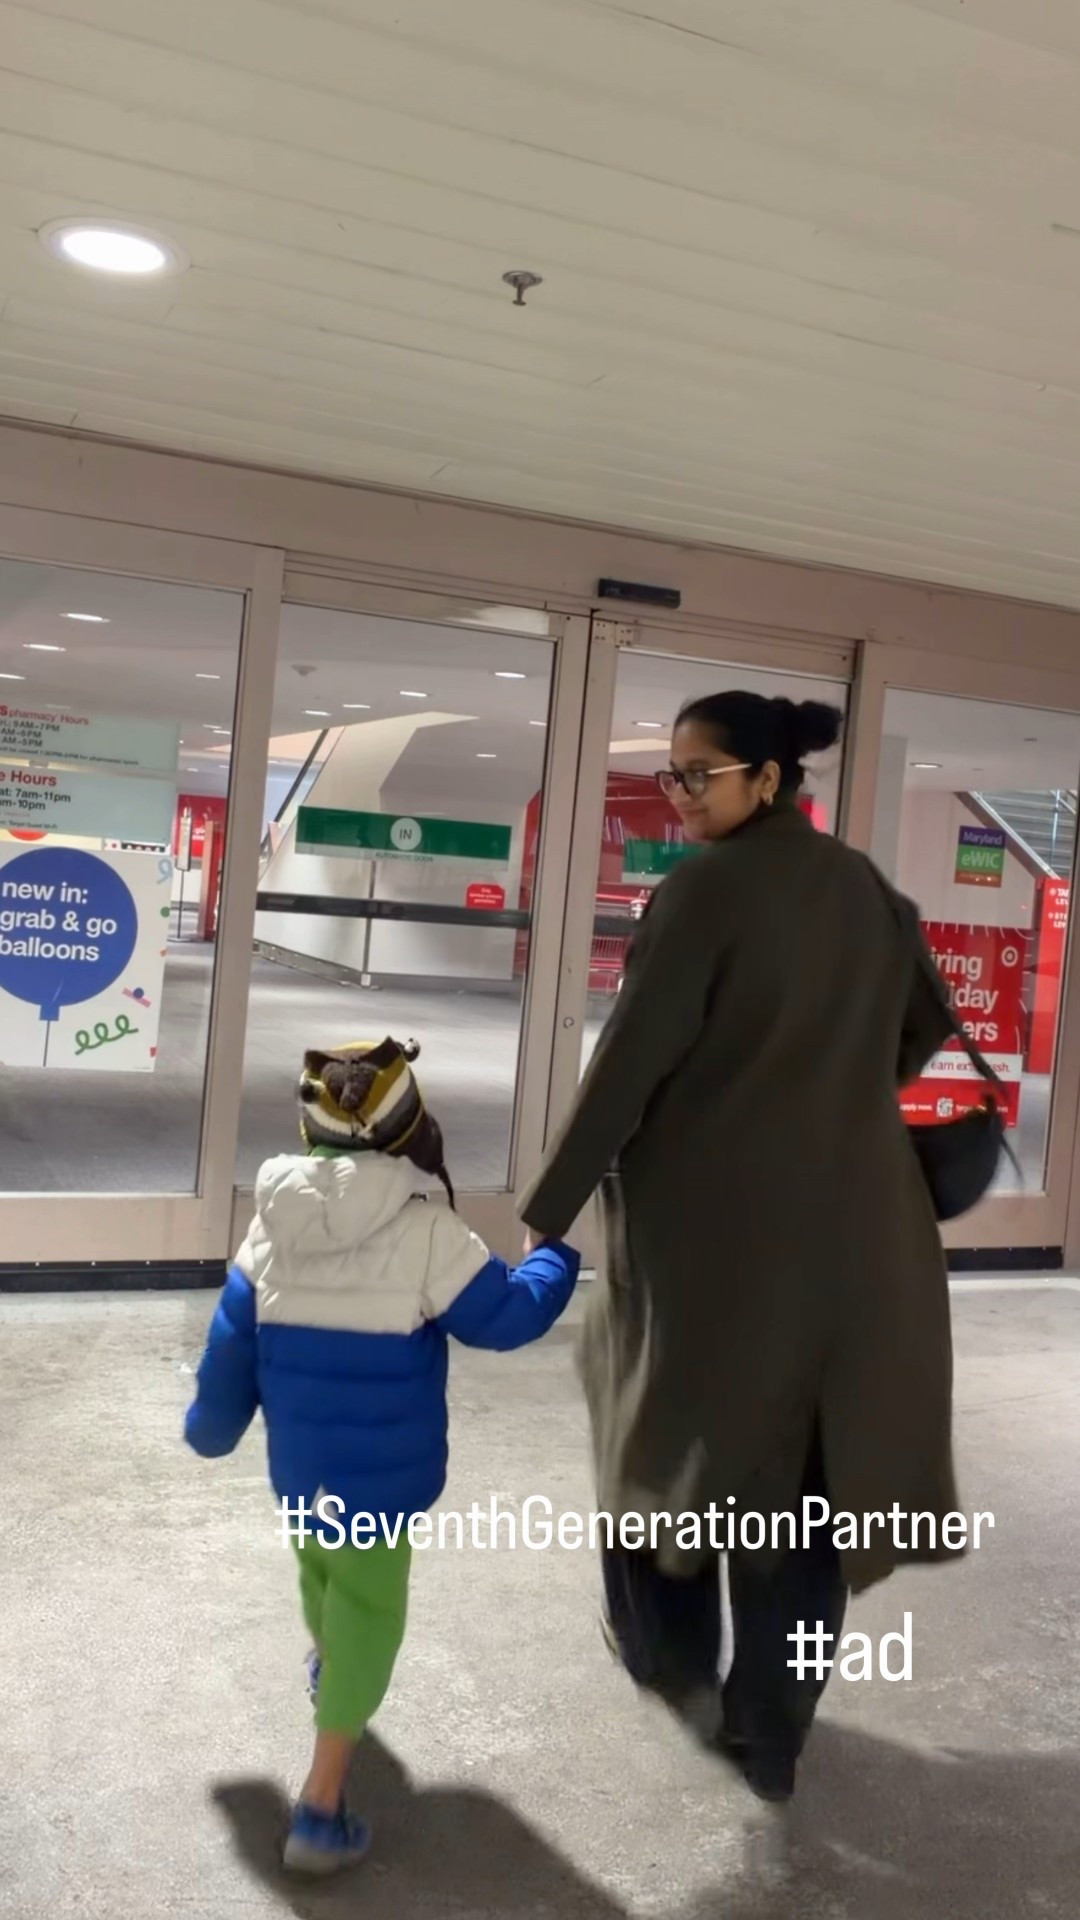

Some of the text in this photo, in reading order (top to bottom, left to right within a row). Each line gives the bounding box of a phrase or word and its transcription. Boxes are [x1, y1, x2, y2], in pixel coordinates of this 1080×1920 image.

[9, 709, 57, 723] pharmacy
[60, 714, 89, 726] Hours
[11, 770, 57, 787] Hours
[15, 788, 71, 803] 7am-11pm
[399, 829, 413, 841] IN
[962, 831, 1003, 846] Maryland
[961, 851, 1001, 869] eWIC
[2, 881, 88, 904] new in:
[0, 909, 117, 938] grab & go
[0, 935, 100, 962] balloons
[930, 946, 983, 981] iring
